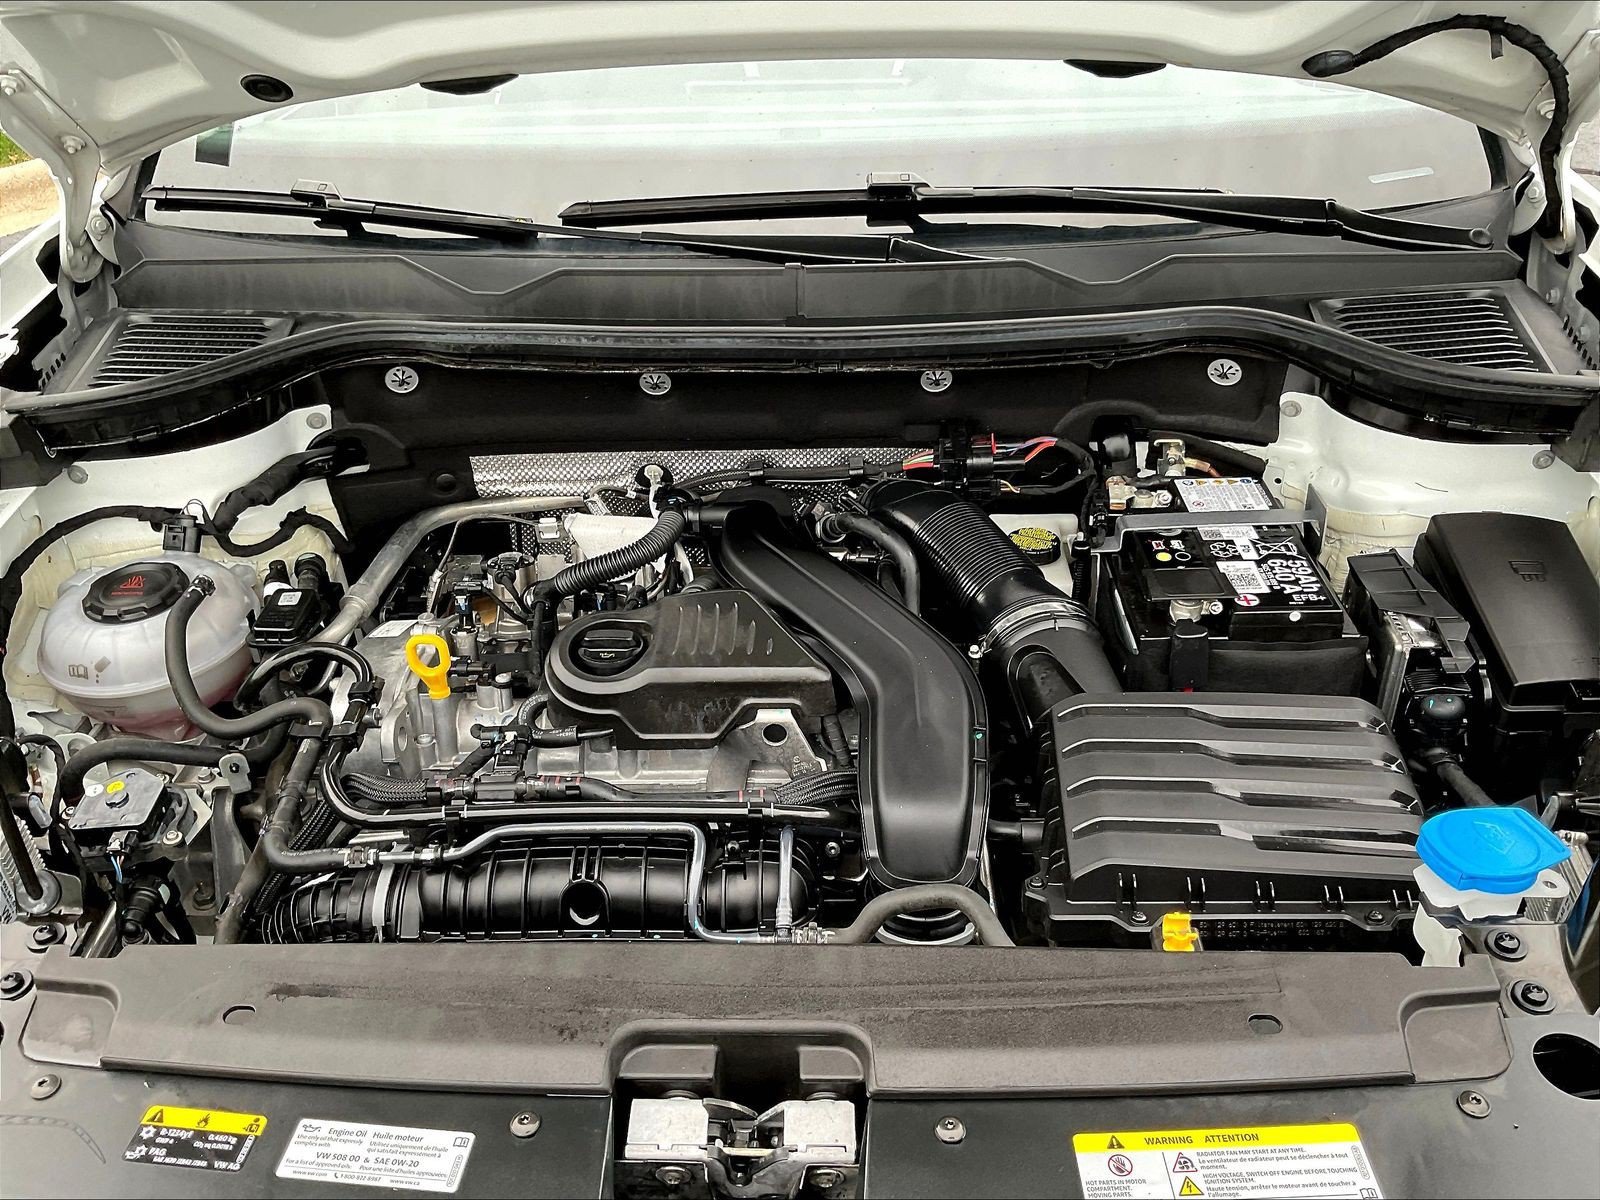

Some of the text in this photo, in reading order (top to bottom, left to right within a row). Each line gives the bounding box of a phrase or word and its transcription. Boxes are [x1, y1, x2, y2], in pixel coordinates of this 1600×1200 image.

[1267, 559, 1296, 581] 640
[1288, 560, 1321, 592] 59Ah
[1280, 584, 1303, 594] A
[328, 1128, 354, 1137] Engine
[373, 1132, 424, 1142] Huile moteur
[1144, 1133, 1259, 1145] WARNING ATTENTION
[148, 1147, 167, 1156] PAG
[390, 1143, 423, 1151] uniquement
[316, 1152, 332, 1160] VW
[332, 1153, 347, 1161] 508
[348, 1154, 360, 1162] 00
[374, 1157, 390, 1165] SAE
[391, 1159, 420, 1167] 0W-20
[214, 1161, 240, 1170] VW AG
